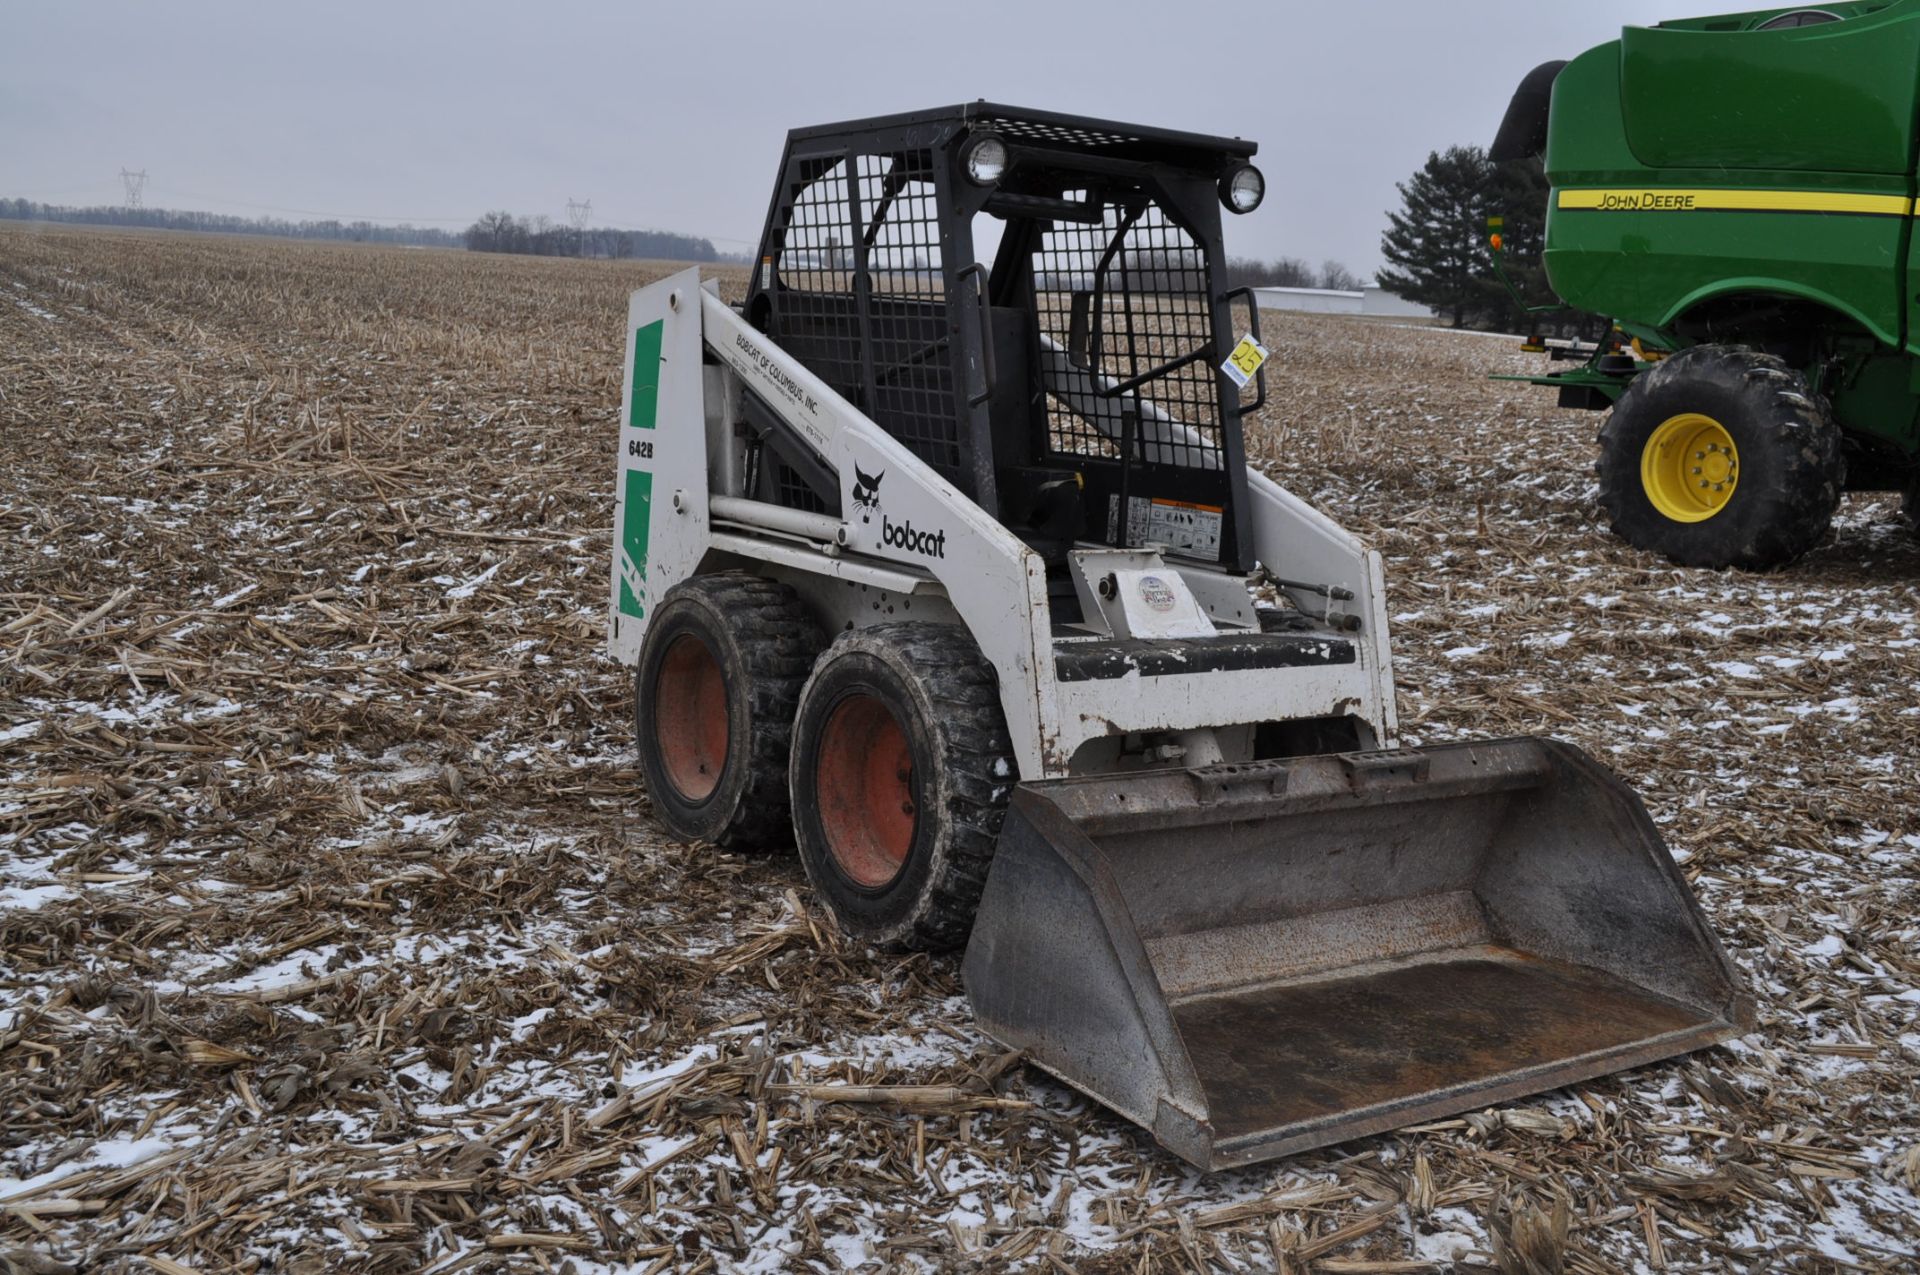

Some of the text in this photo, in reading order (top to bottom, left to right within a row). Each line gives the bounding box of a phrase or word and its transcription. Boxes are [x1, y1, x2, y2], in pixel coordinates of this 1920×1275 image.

[1597, 193, 1695, 207] JOHN DEERE
[736, 334, 760, 362] BOBCAT
[760, 356, 770, 369] OF
[1232, 341, 1263, 373] 25
[629, 440, 653, 459] 642B
[883, 514, 945, 559] bobcat
